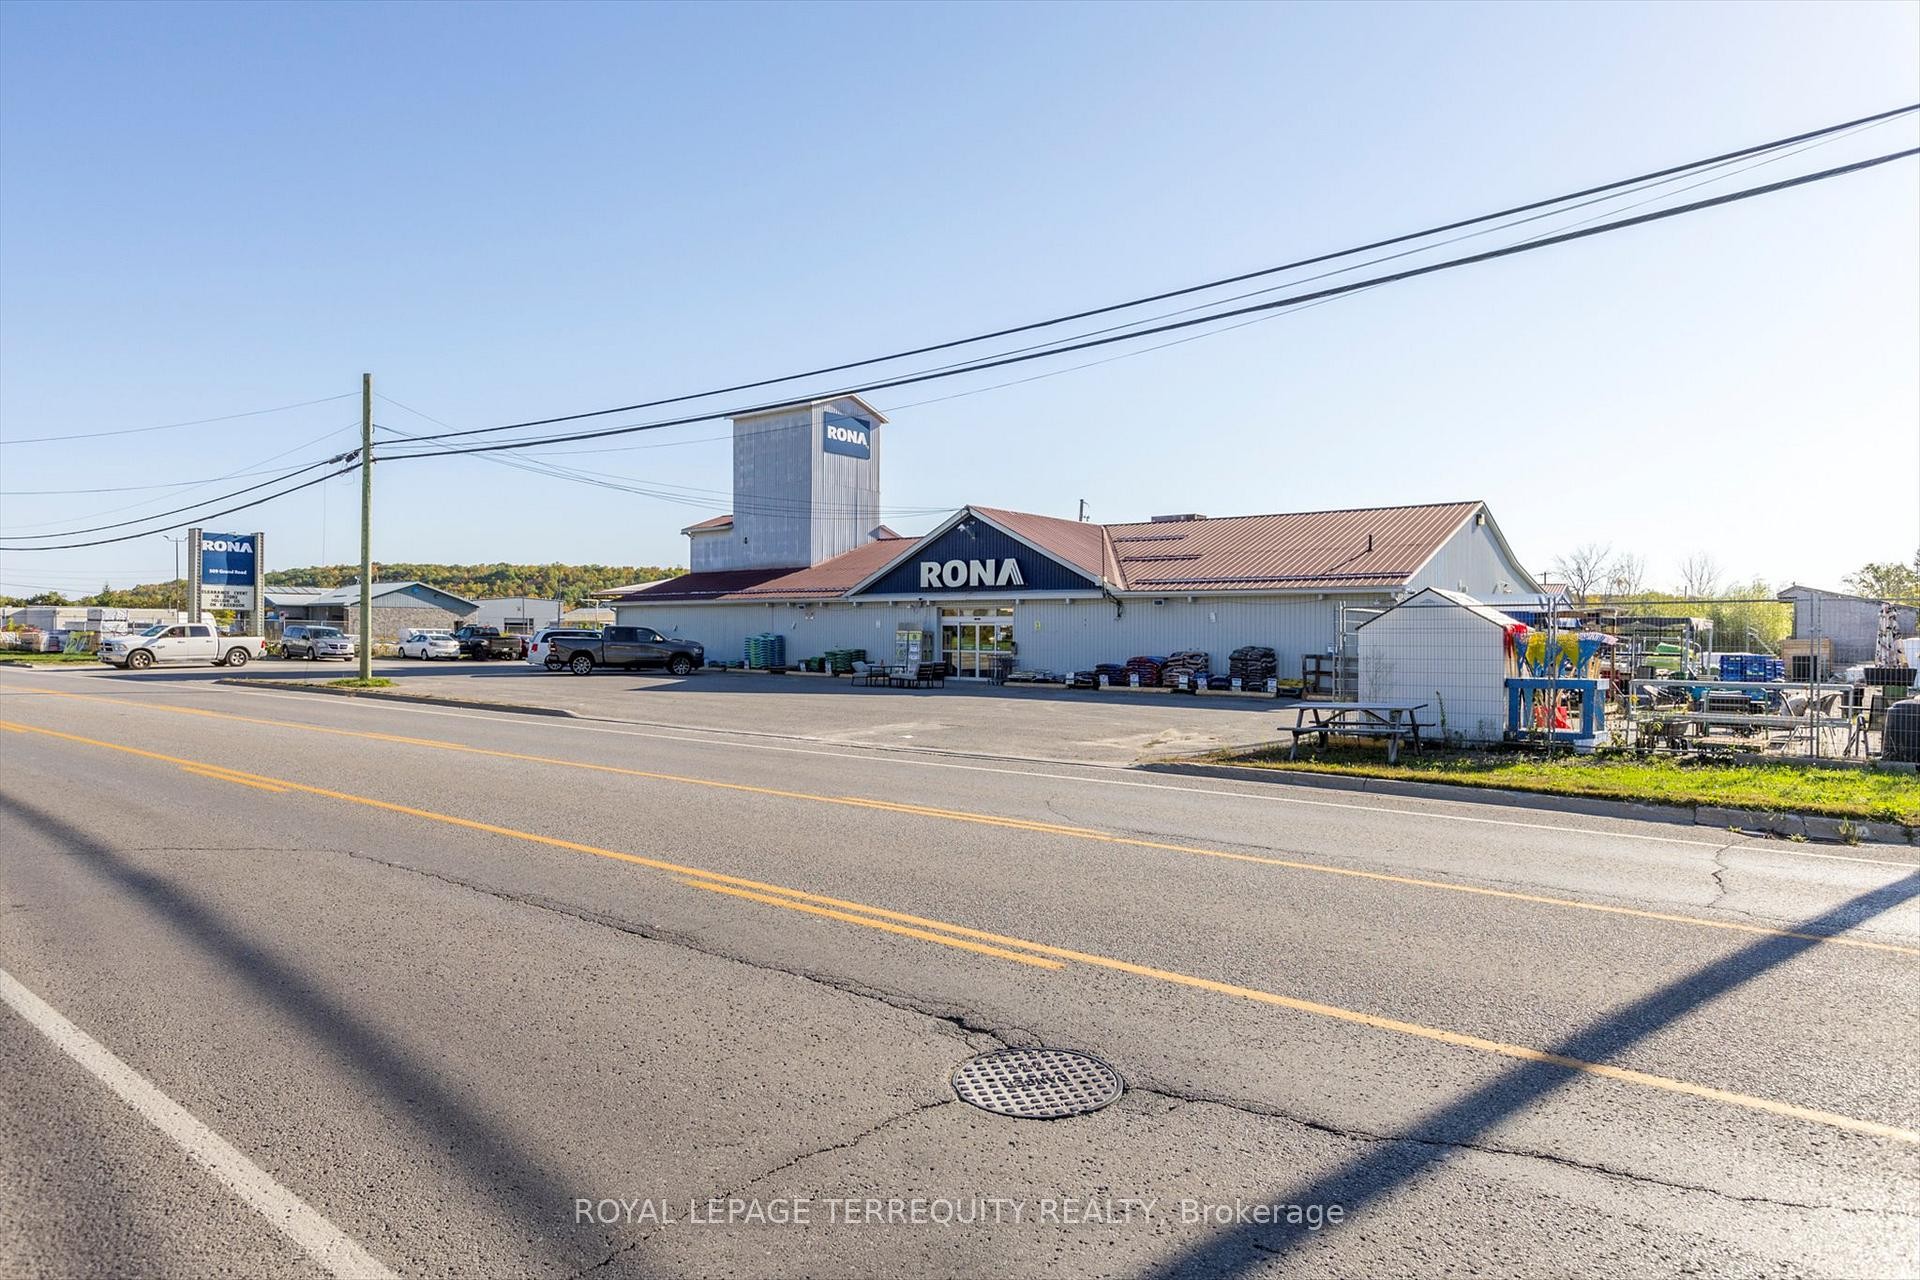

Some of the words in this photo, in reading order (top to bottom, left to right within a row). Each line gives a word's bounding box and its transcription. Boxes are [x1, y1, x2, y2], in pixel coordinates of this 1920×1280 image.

[827, 425, 868, 446] RONA
[202, 540, 253, 553] RONA
[920, 558, 1024, 588] RONA
